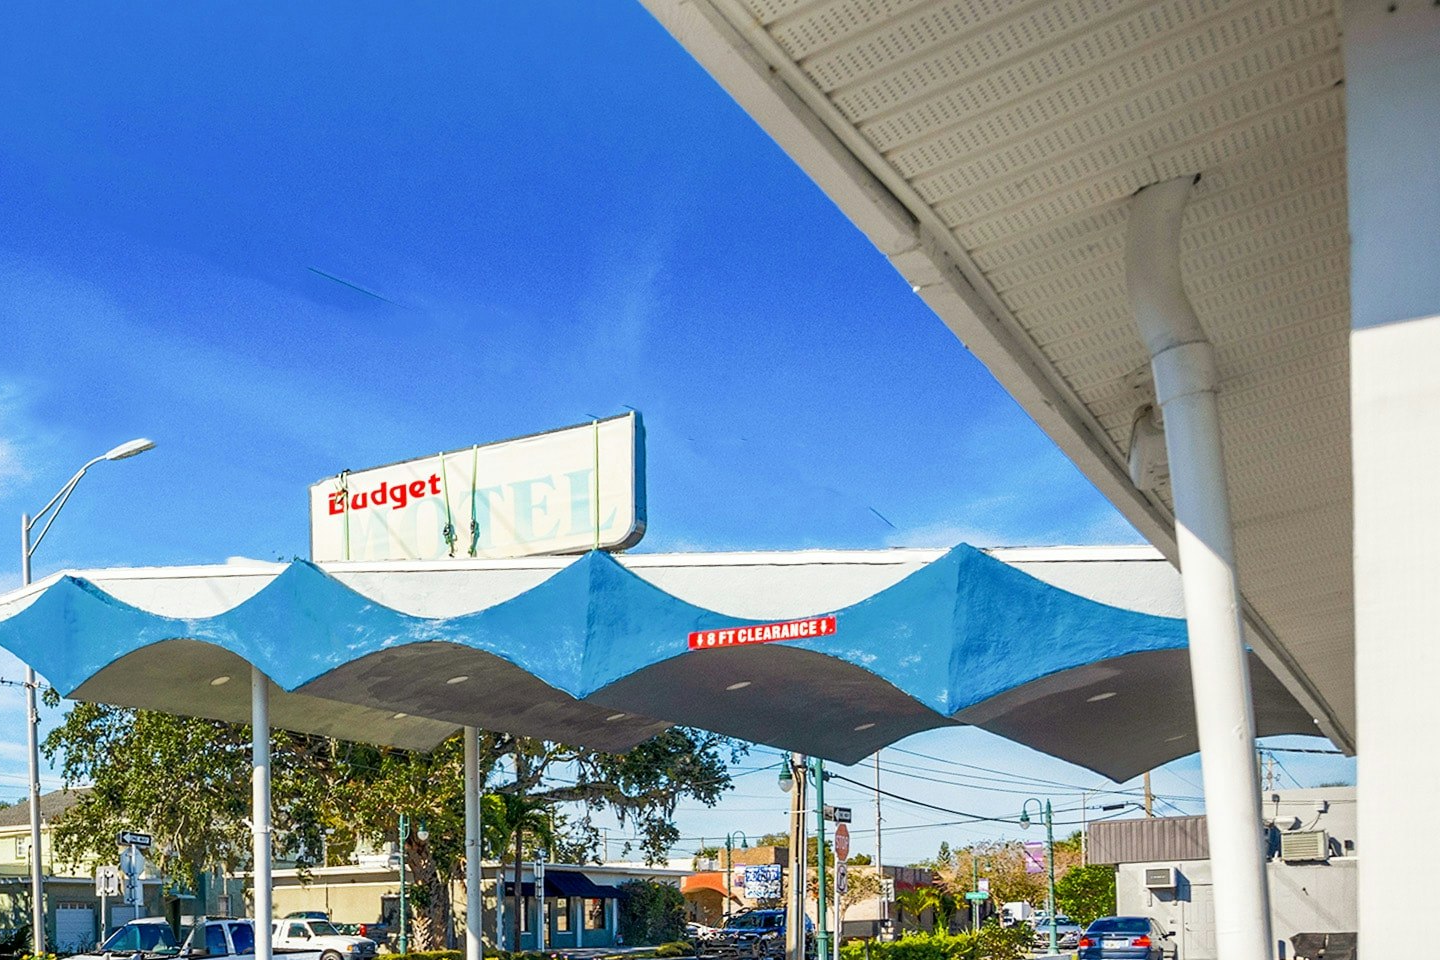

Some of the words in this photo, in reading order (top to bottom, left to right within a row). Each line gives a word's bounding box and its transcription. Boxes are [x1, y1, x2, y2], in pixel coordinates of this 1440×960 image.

[327, 472, 442, 516] Budget
[706, 632, 716, 645] 8
[718, 631, 735, 644] FT
[737, 620, 817, 643] CLEARANCE
